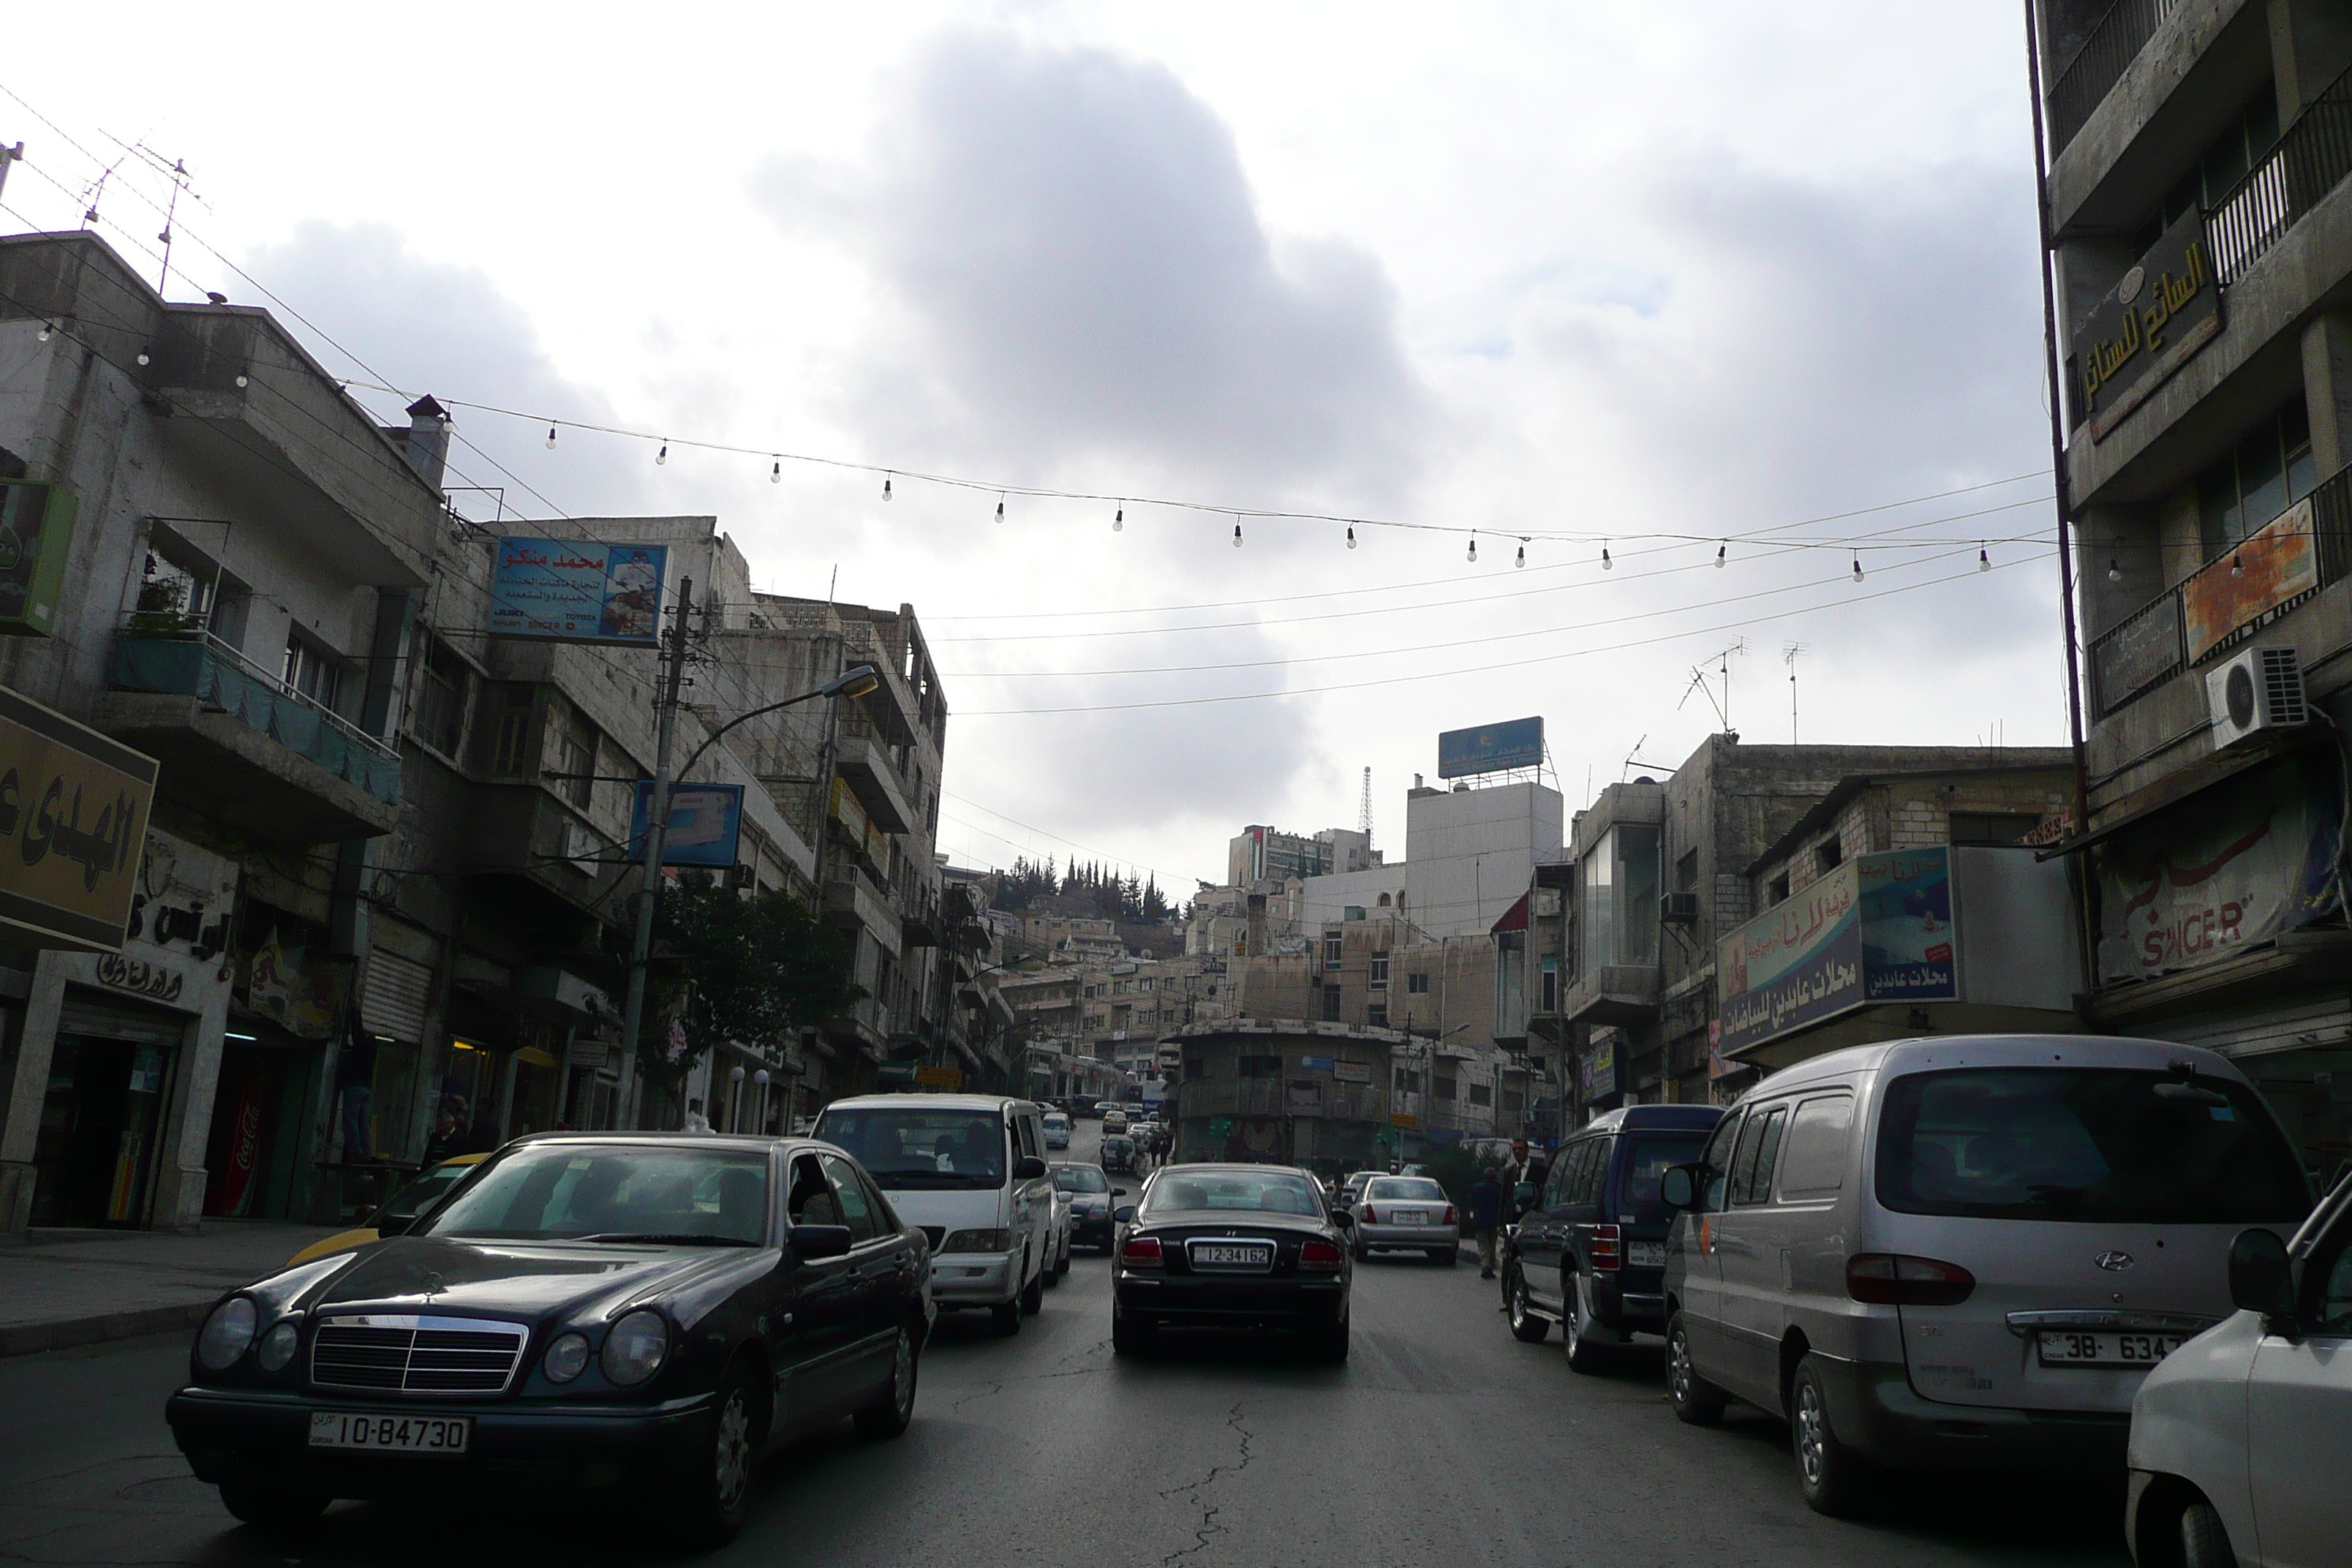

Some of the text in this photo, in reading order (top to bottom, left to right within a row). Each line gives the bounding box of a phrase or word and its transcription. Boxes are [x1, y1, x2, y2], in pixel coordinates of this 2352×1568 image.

[552, 554, 604, 569] محمد
[528, 621, 560, 630] SINGER
[566, 613, 596, 621] TOYOTA
[1812, 957, 1856, 1000] محلات
[1869, 966, 1948, 997] محلات عابدين
[1771, 973, 1810, 1030] عابدين
[1208, 1248, 1266, 1262] 12-34162
[341, 1417, 464, 1448] 10-84730
